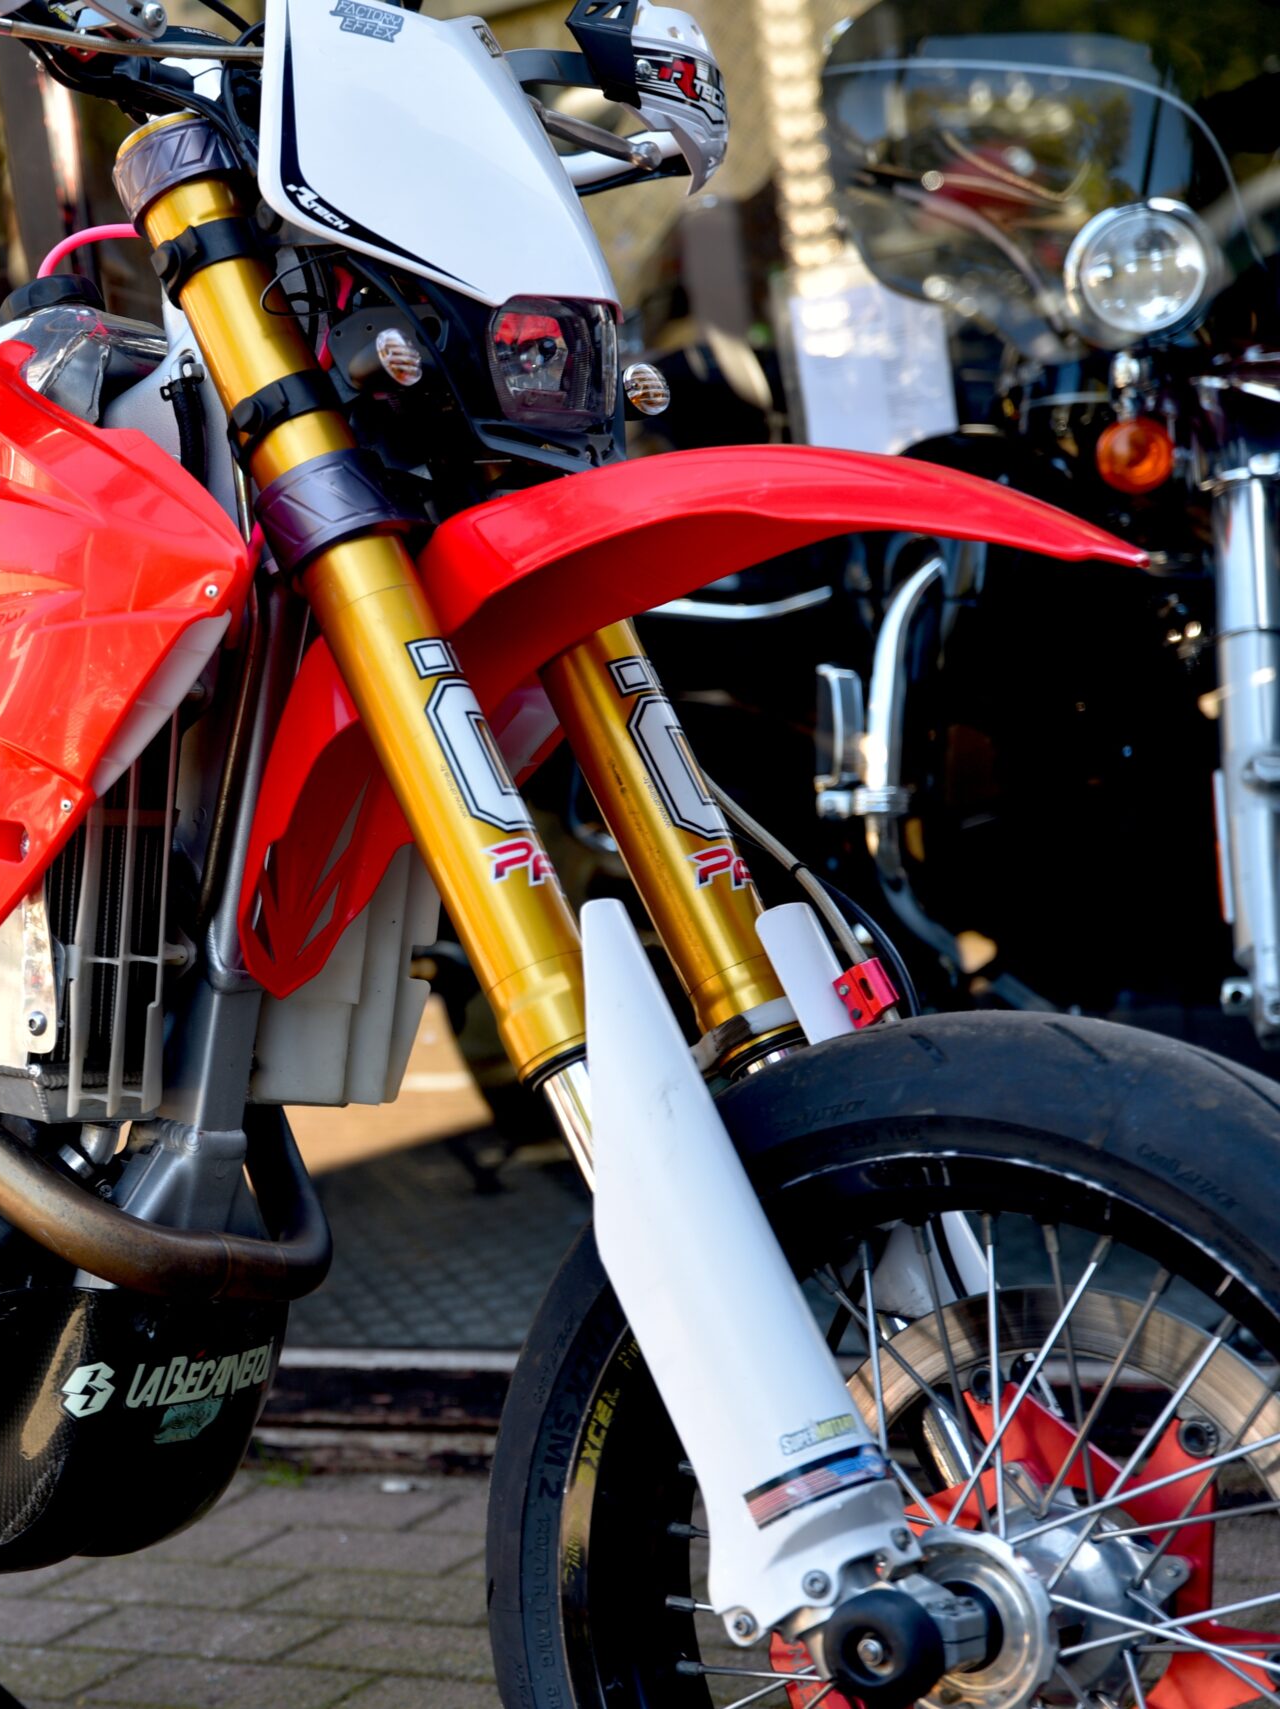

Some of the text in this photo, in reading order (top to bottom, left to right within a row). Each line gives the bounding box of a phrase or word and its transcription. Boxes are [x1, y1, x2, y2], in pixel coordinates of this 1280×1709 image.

[336, 0, 403, 27] FACTORY
[342, 17, 395, 41] EFFEX
[543, 1409, 578, 1468] SM
[538, 1476, 561, 1500] 2
[534, 1585, 550, 1599] R
